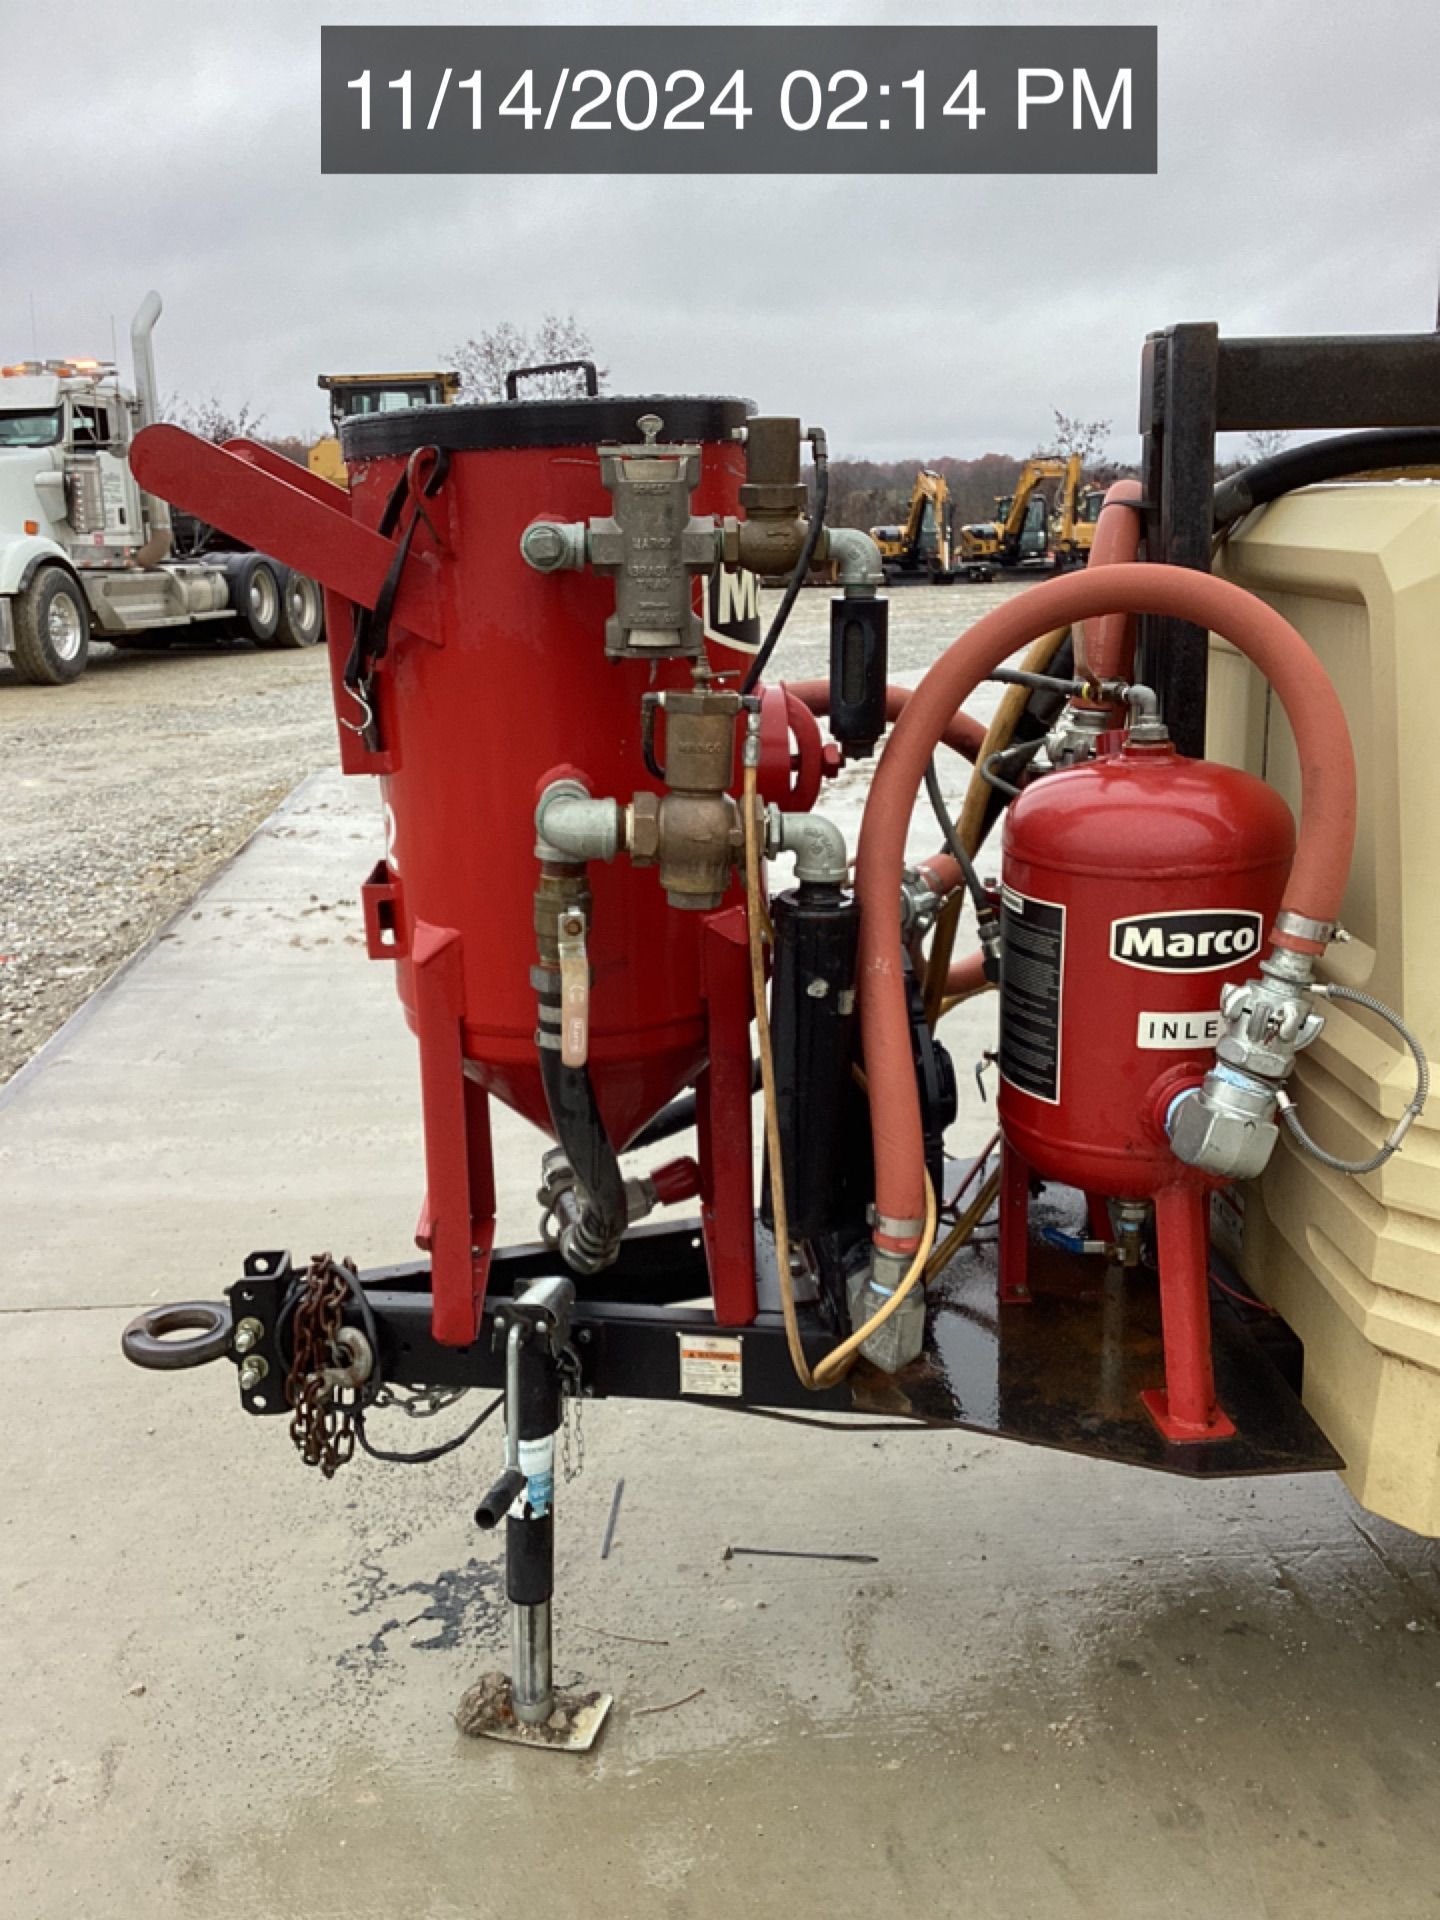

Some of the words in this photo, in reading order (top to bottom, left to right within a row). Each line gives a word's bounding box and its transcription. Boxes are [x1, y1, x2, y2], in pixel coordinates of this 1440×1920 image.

[718, 562, 760, 624] M
[1121, 926, 1255, 957] Marco
[1149, 1019, 1219, 1039] INLE
